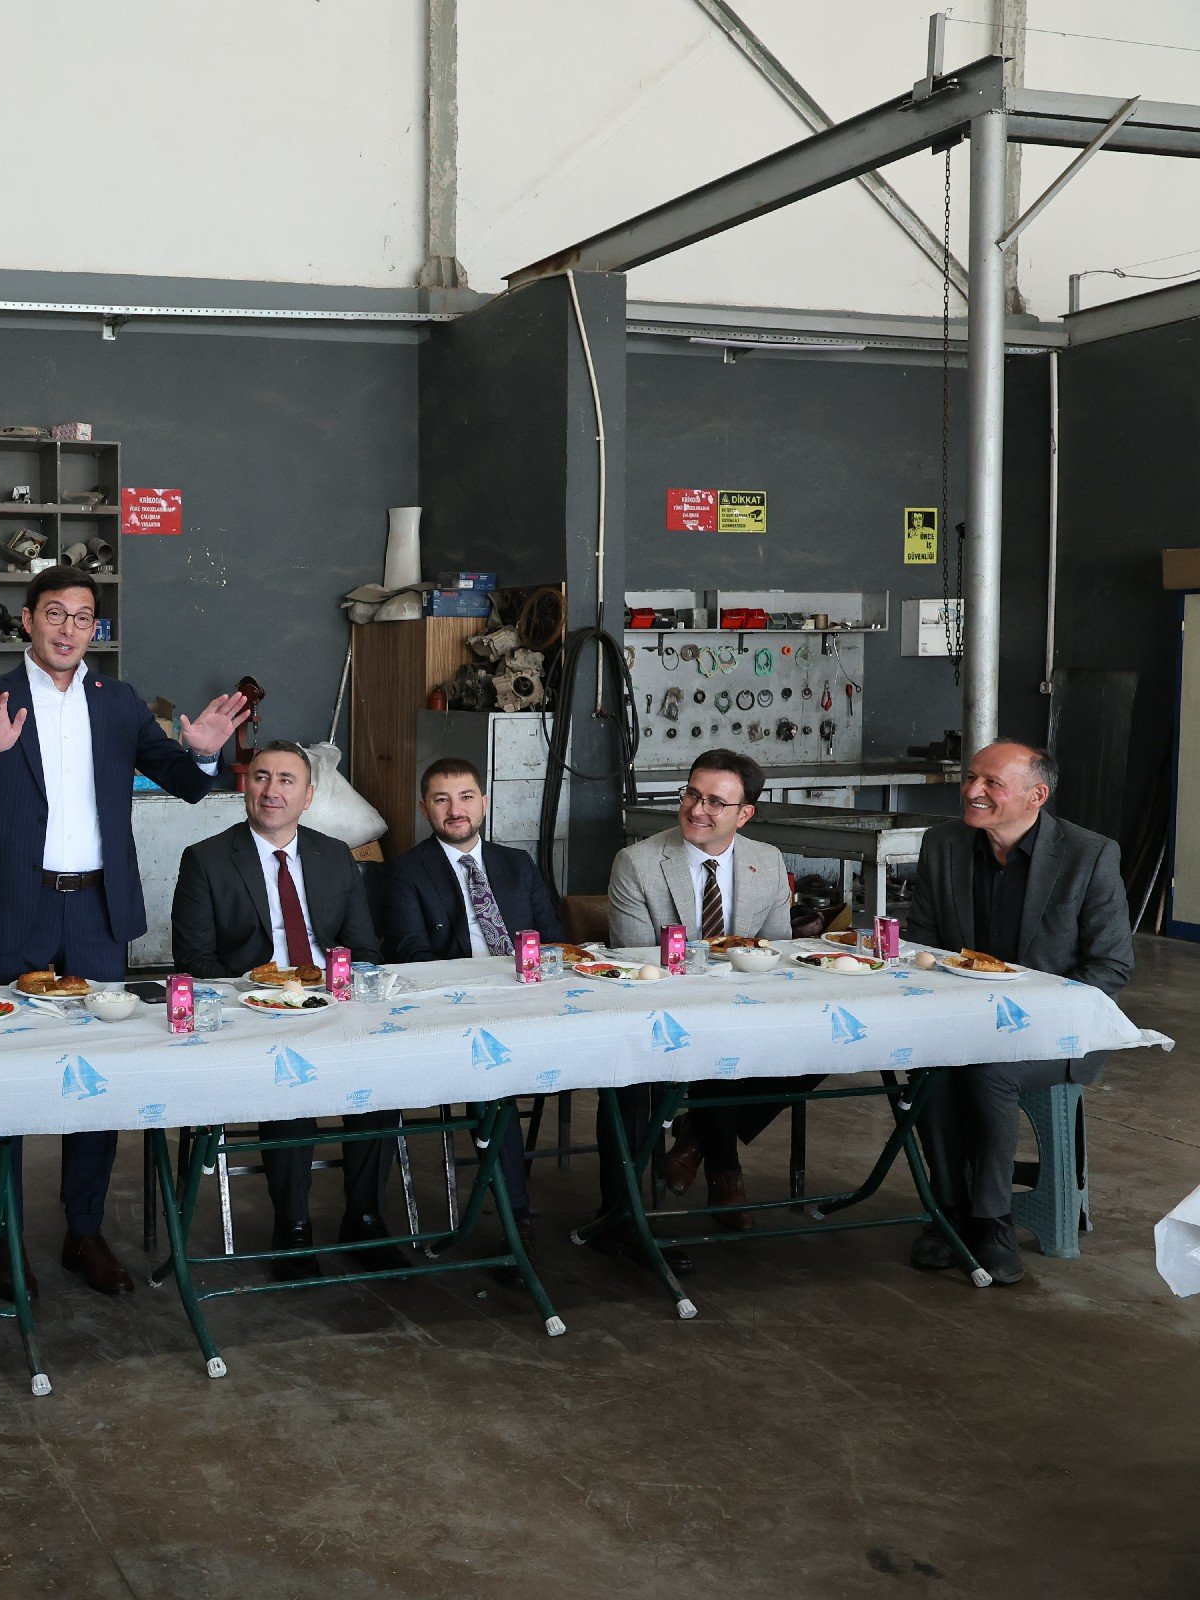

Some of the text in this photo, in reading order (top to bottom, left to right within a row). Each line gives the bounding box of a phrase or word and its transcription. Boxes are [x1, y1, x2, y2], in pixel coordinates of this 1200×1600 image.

[731, 494, 762, 504] DİKKAT
[920, 532, 935, 540] ÖNCE
[926, 541, 932, 550] İŞ
[907, 552, 935, 560] GÜVENLİĞİ
